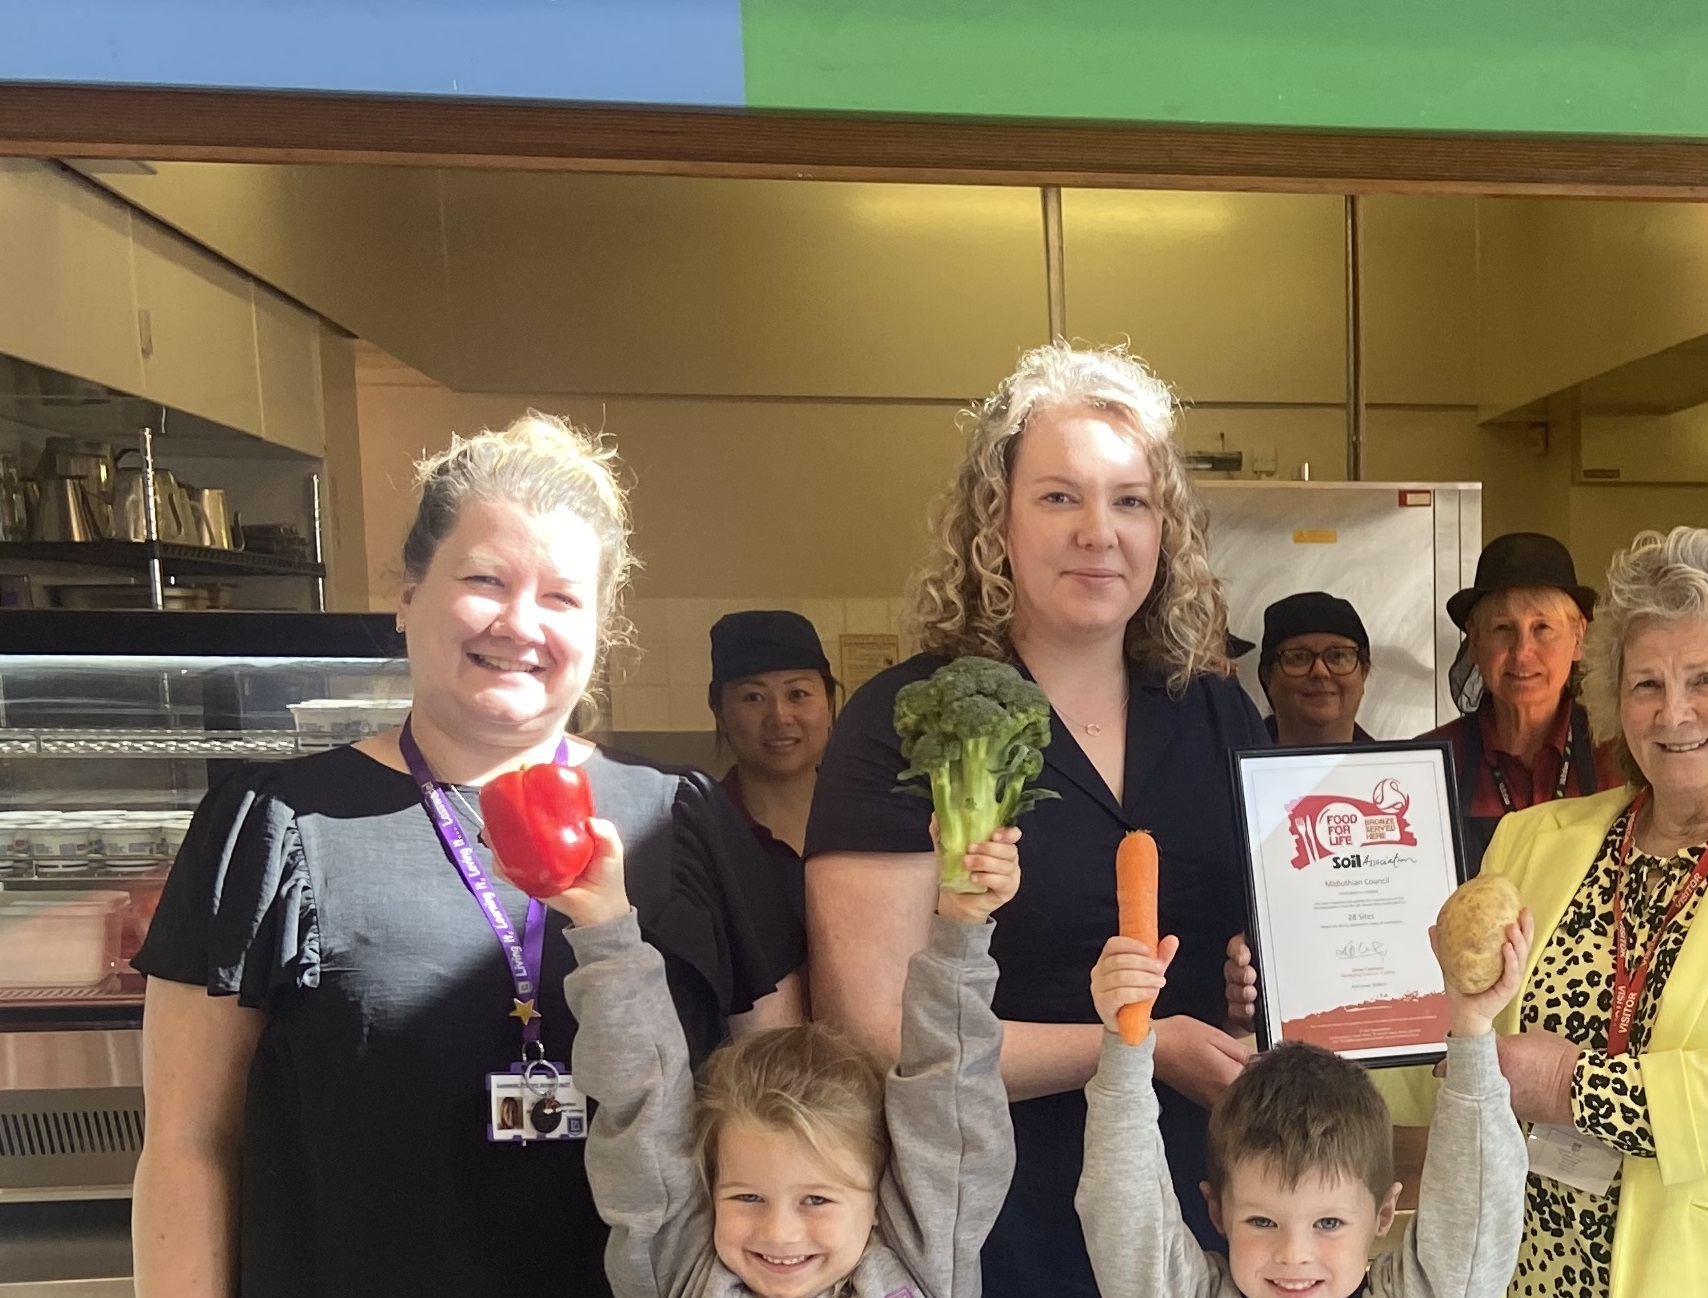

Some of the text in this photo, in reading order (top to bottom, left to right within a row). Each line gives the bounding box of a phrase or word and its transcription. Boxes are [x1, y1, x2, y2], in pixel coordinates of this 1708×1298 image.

[1327, 814, 1357, 824] FOOD
[1328, 825, 1350, 835] FOR
[1329, 836, 1352, 846] LIFE
[460, 847, 480, 877] Loving
[1364, 877, 1389, 885] Council
[1675, 872, 1702, 909] VISITOR
[483, 892, 508, 929] Learning
[511, 946, 527, 977] Living
[1617, 992, 1638, 1034] VISITOR
